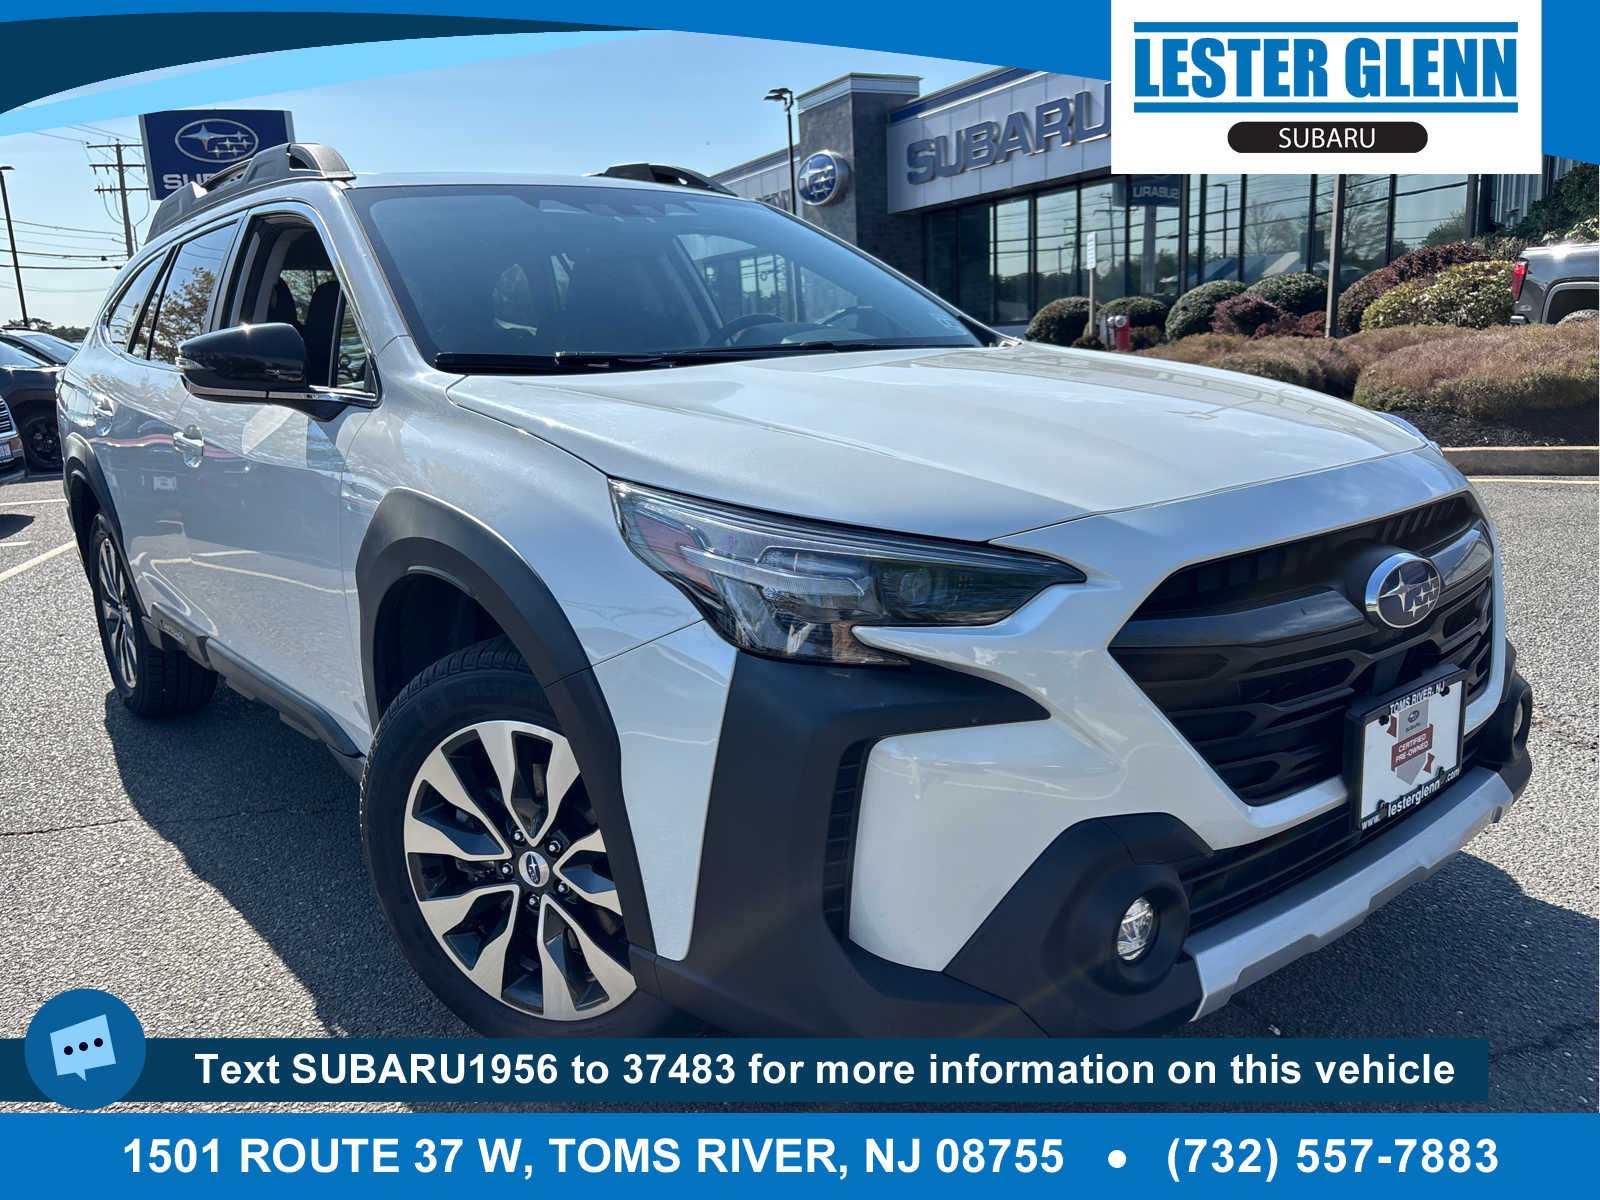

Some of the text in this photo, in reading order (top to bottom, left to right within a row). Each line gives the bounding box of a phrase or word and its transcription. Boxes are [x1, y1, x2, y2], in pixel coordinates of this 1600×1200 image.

[907, 82, 1112, 184] SUBARU
[1391, 697, 1411, 714] TOMS
[1395, 740, 1429, 763] PRE-OWNED
[1398, 733, 1427, 753] CERTIFIED
